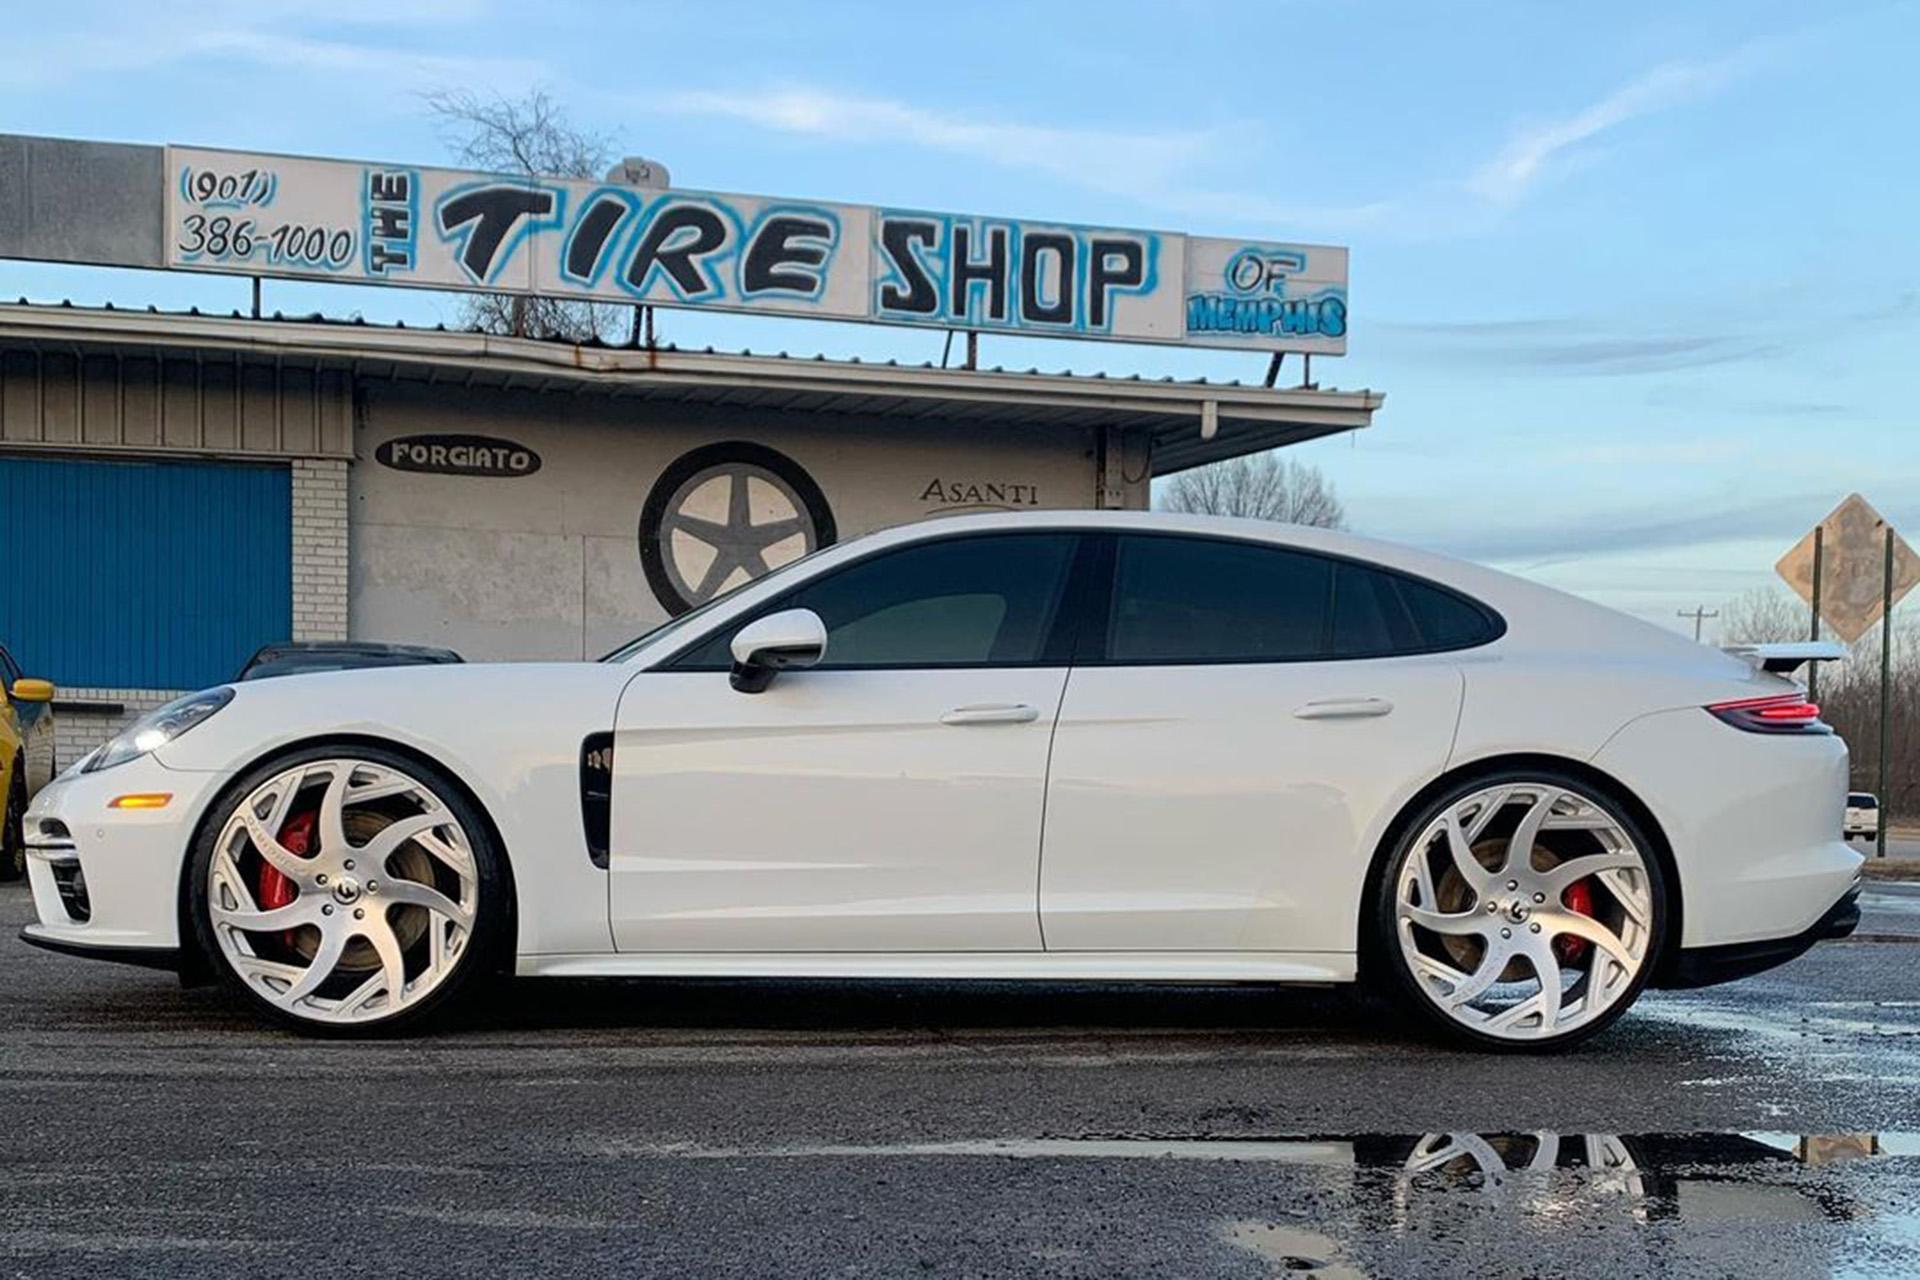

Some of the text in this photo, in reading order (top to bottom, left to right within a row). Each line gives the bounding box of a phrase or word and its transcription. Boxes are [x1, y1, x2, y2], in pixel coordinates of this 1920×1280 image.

[186, 167, 271, 205] (901)
[178, 213, 351, 263] 386-1000
[370, 171, 409, 273] THE
[440, 186, 1143, 327] TIRE SHOP
[1231, 254, 1298, 292] OF
[1186, 293, 1348, 338] MEMPHIS
[391, 442, 531, 471] FORGIATO
